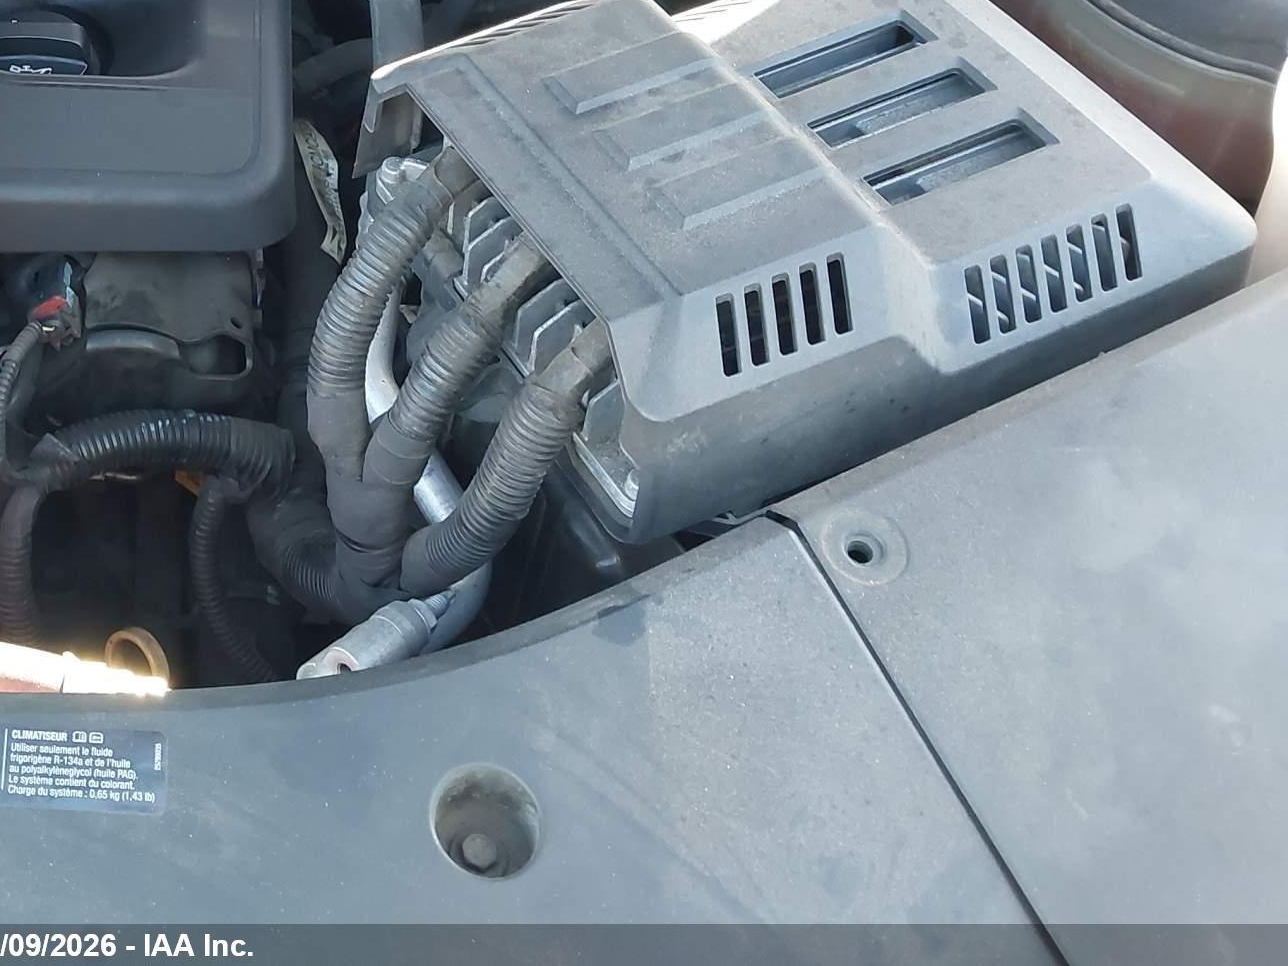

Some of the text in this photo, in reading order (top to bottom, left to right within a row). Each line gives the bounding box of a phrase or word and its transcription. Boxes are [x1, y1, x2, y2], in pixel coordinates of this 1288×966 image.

[12, 730, 67, 741] CLIMATISEUR
[11, 743, 113, 757] Utiliser seulement le fluide
[54, 755, 83, 765] R-134a
[85, 757, 93, 766] et
[95, 758, 105, 767] de
[93, 769, 116, 778] (huile
[8, 774, 18, 783] Le
[55, 778, 86, 787] contient
[88, 778, 99, 787] du
[100, 780, 135, 789] colorant.
[8, 785, 36, 796] Charge
[37, 787, 48, 795] du
[109, 790, 120, 801] kg
[144, 792, 155, 803] lb)
